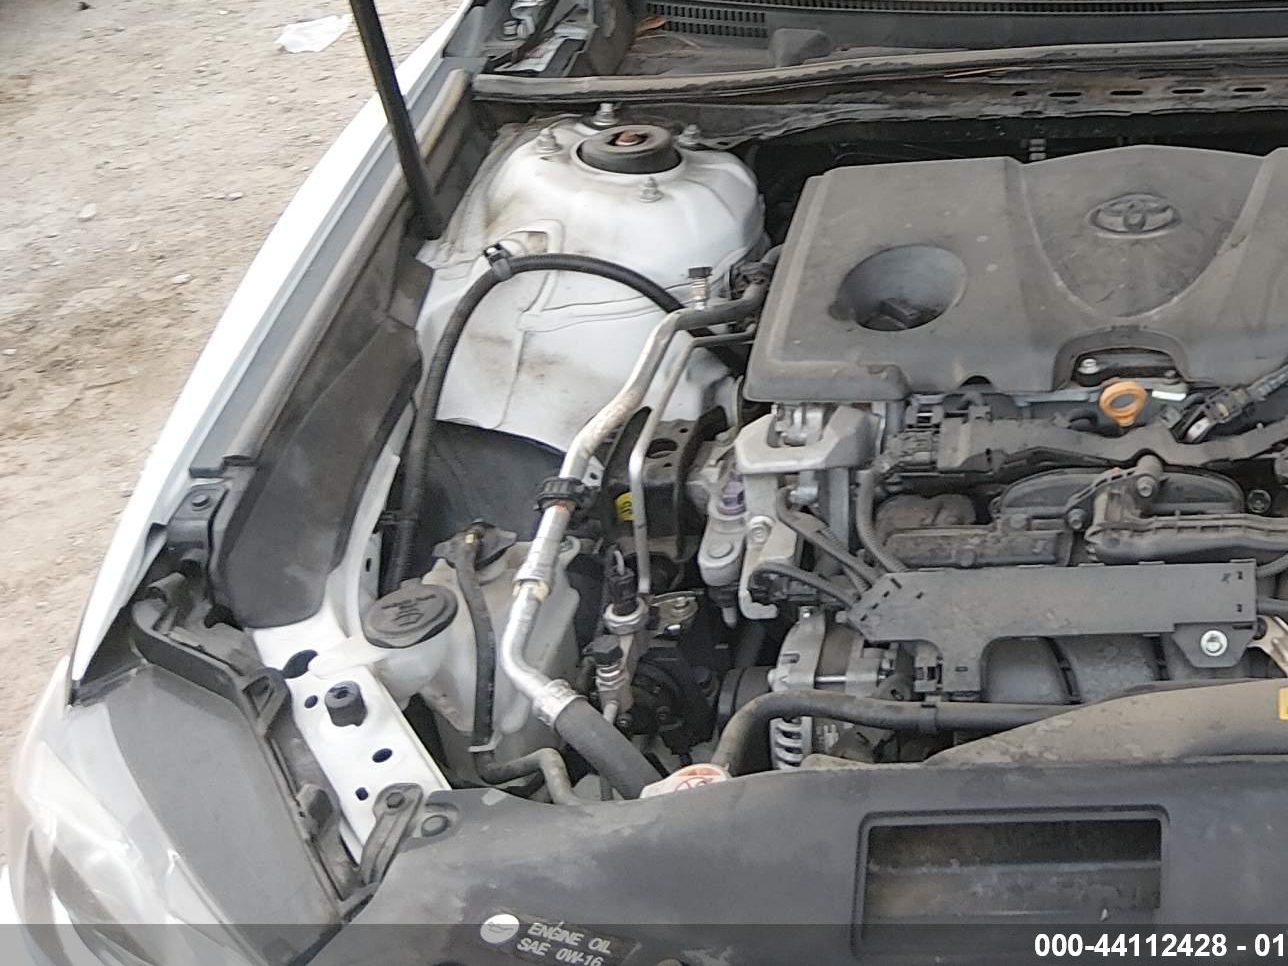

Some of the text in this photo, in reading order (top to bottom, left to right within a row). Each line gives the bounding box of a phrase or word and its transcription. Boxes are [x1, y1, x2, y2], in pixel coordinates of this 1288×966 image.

[517, 938, 604, 966] SAE 0W-16
[527, 922, 612, 955] ENGINE OIL
